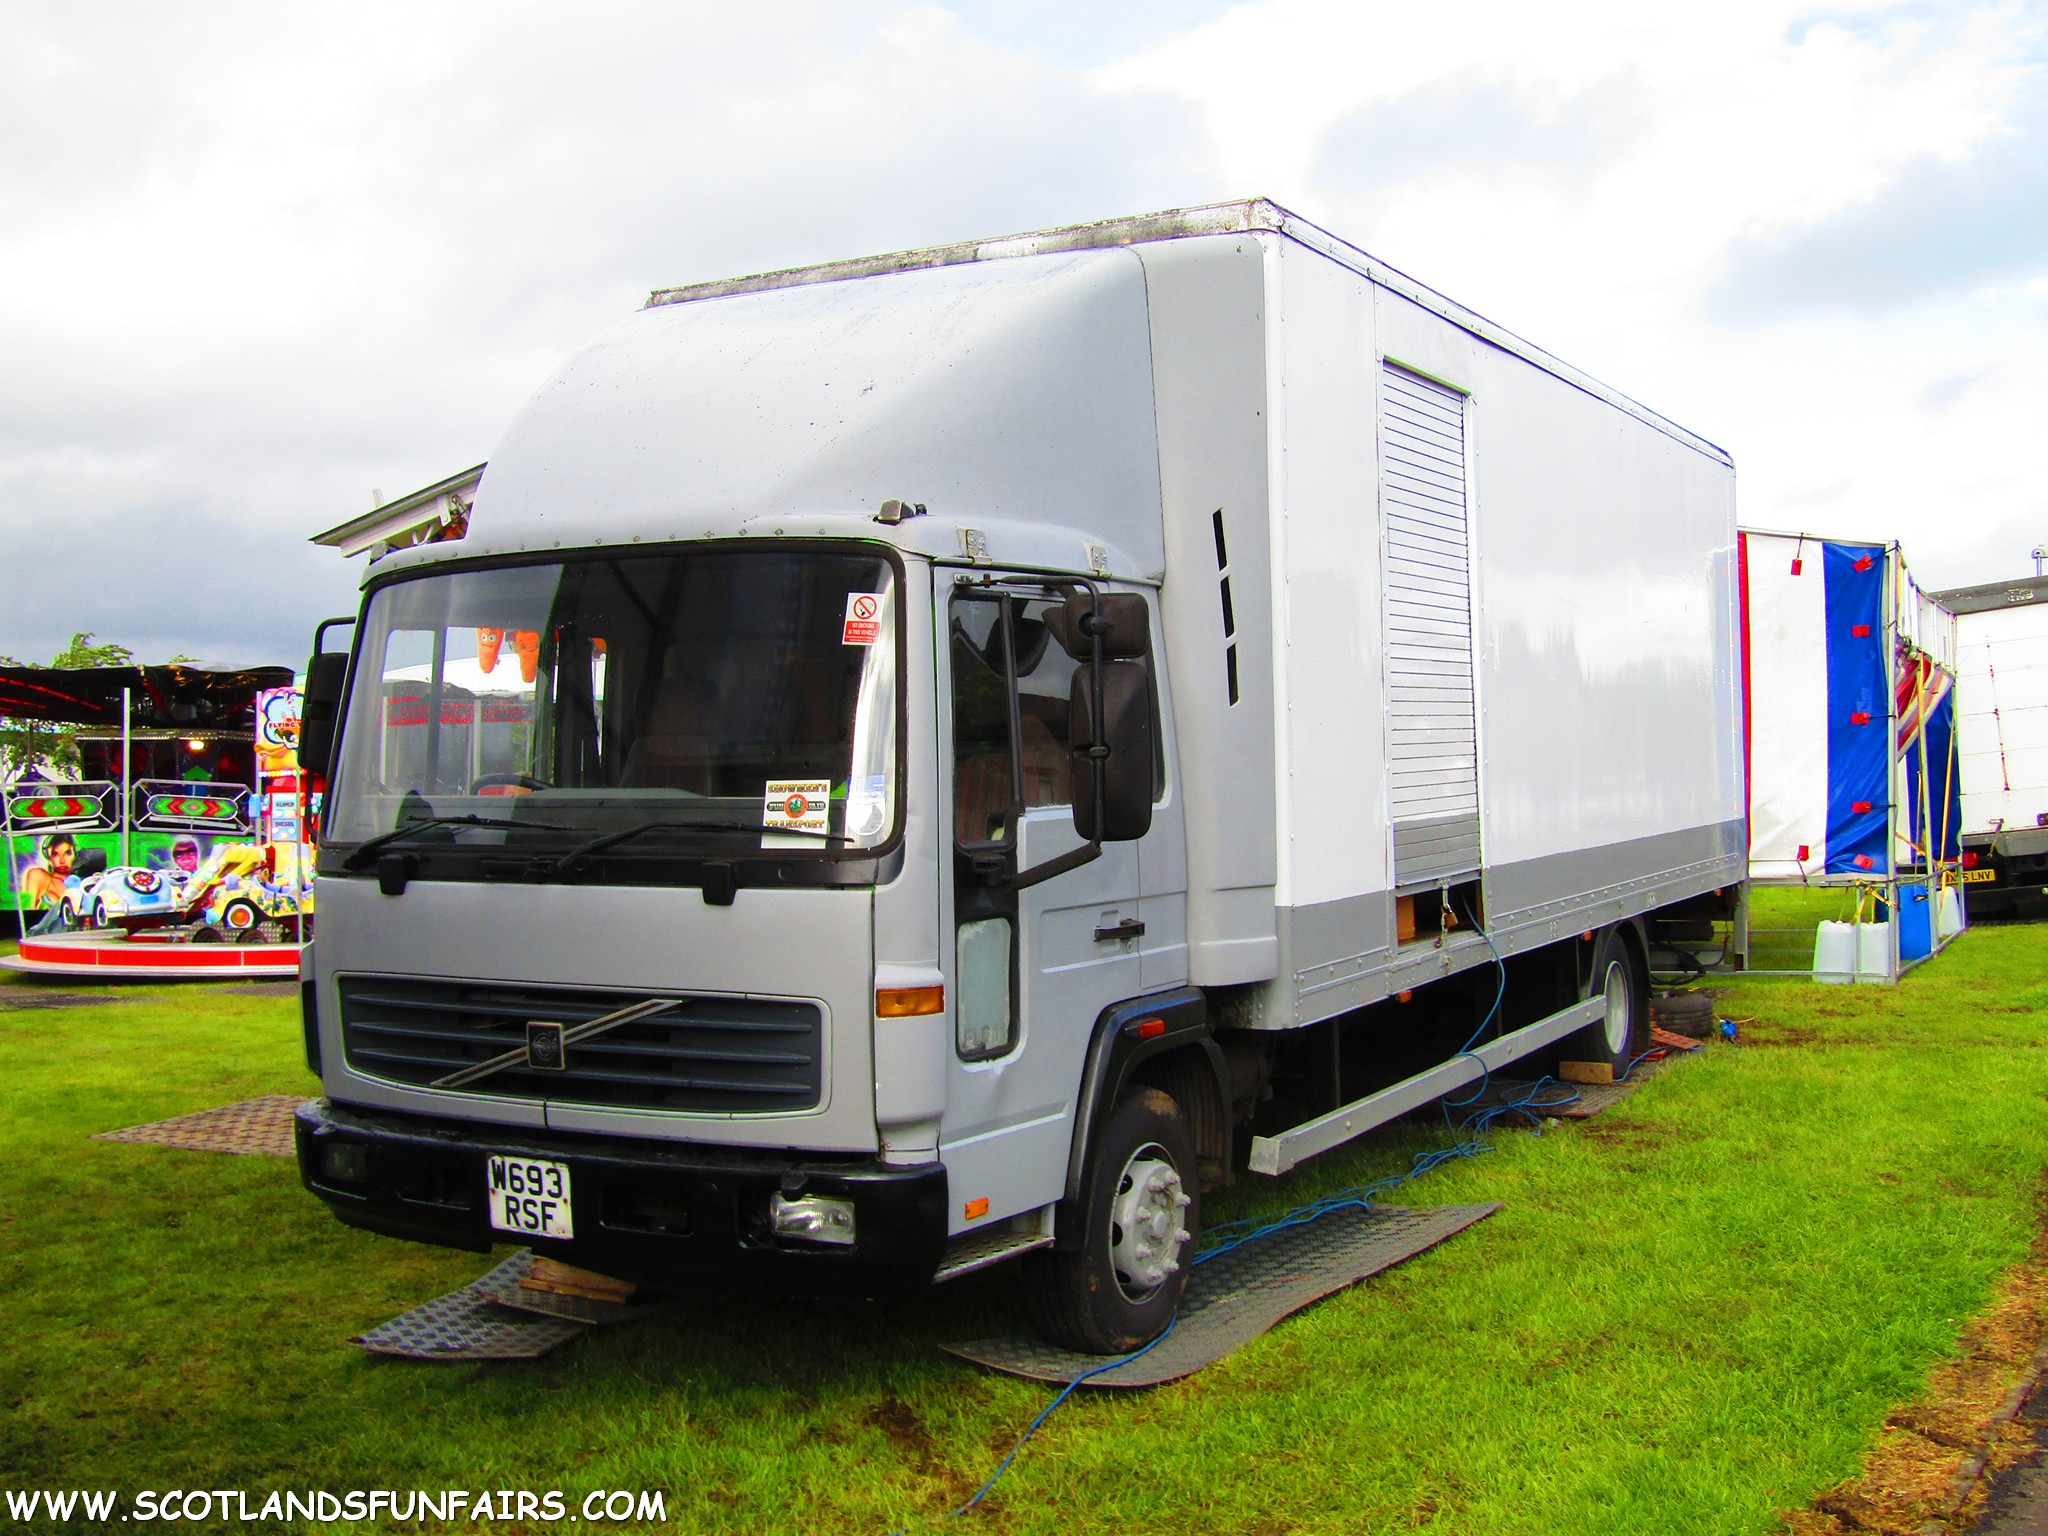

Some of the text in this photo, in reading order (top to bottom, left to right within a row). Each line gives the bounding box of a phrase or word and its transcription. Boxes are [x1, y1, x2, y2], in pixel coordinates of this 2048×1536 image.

[765, 819, 825, 829] TRANSPORT
[1971, 870, 1991, 881] LNV
[491, 1158, 563, 1199] W693
[505, 1195, 557, 1232] RSF
